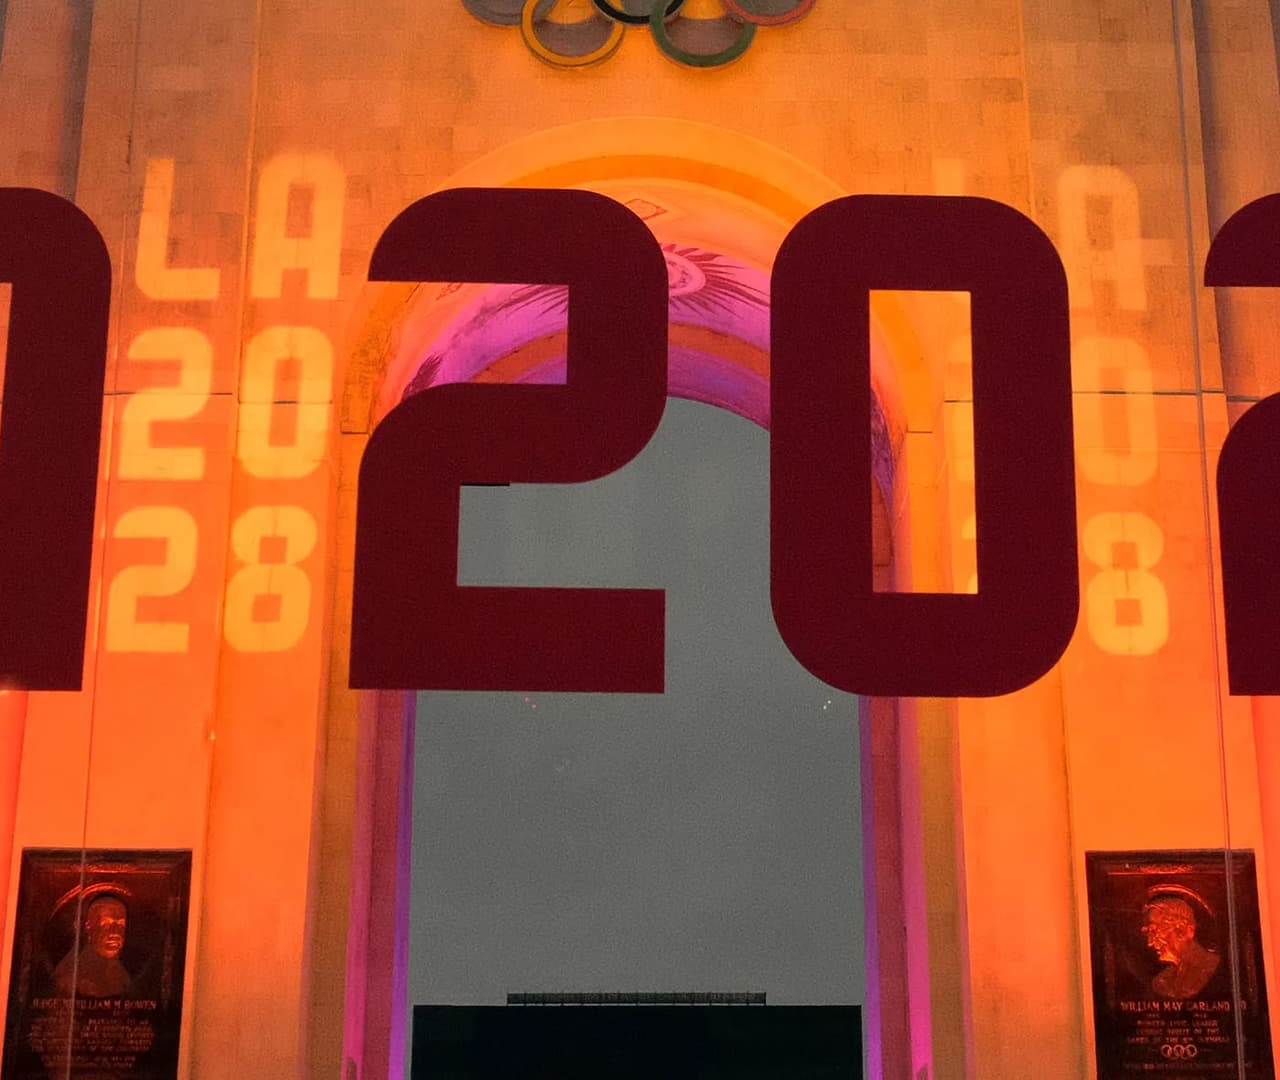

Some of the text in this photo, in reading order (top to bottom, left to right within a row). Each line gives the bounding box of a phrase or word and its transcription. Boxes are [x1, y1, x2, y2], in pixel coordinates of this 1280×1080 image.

[134, 153, 347, 301] LA
[117, 325, 335, 480] 20
[104, 504, 318, 653] 28
